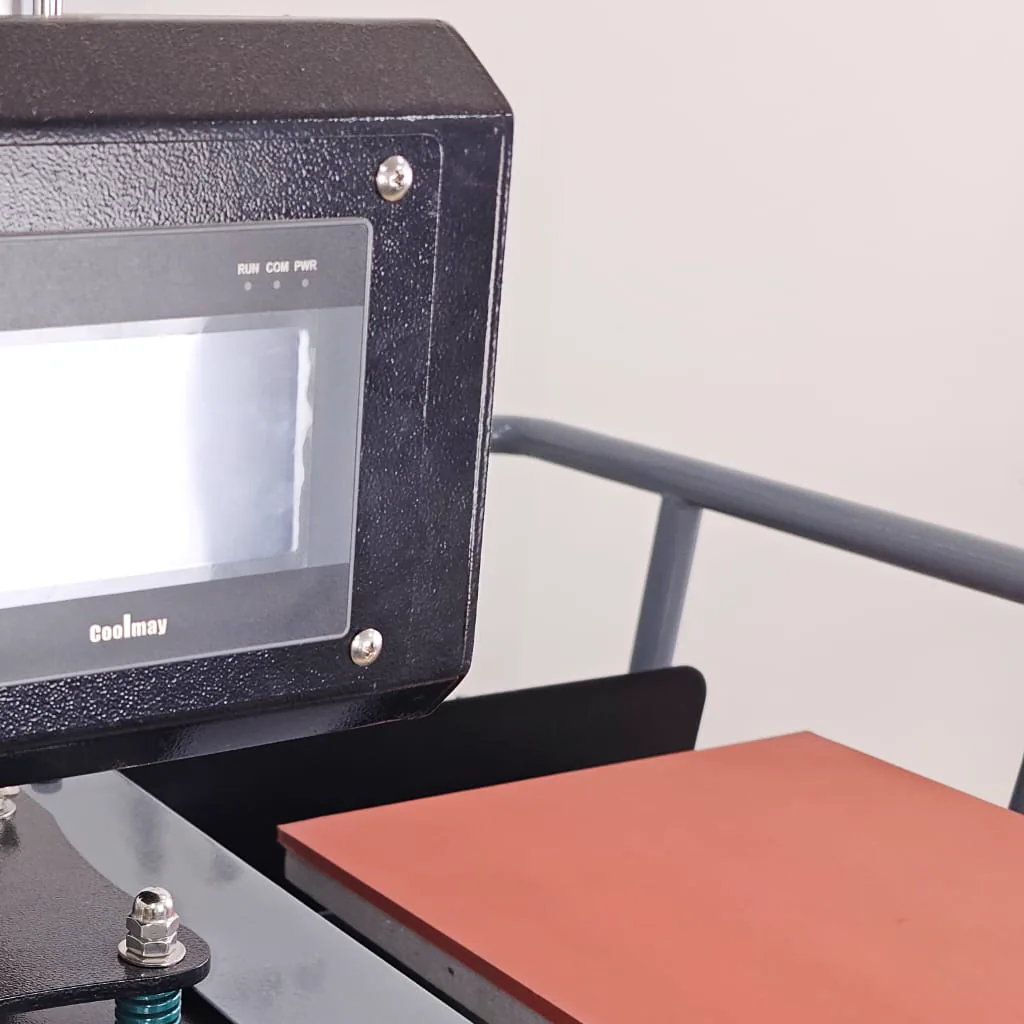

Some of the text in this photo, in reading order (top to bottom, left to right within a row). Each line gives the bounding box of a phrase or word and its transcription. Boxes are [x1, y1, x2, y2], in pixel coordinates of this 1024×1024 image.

[237, 259, 318, 275] RUN COM PWR
[89, 613, 168, 643] Coolmay
